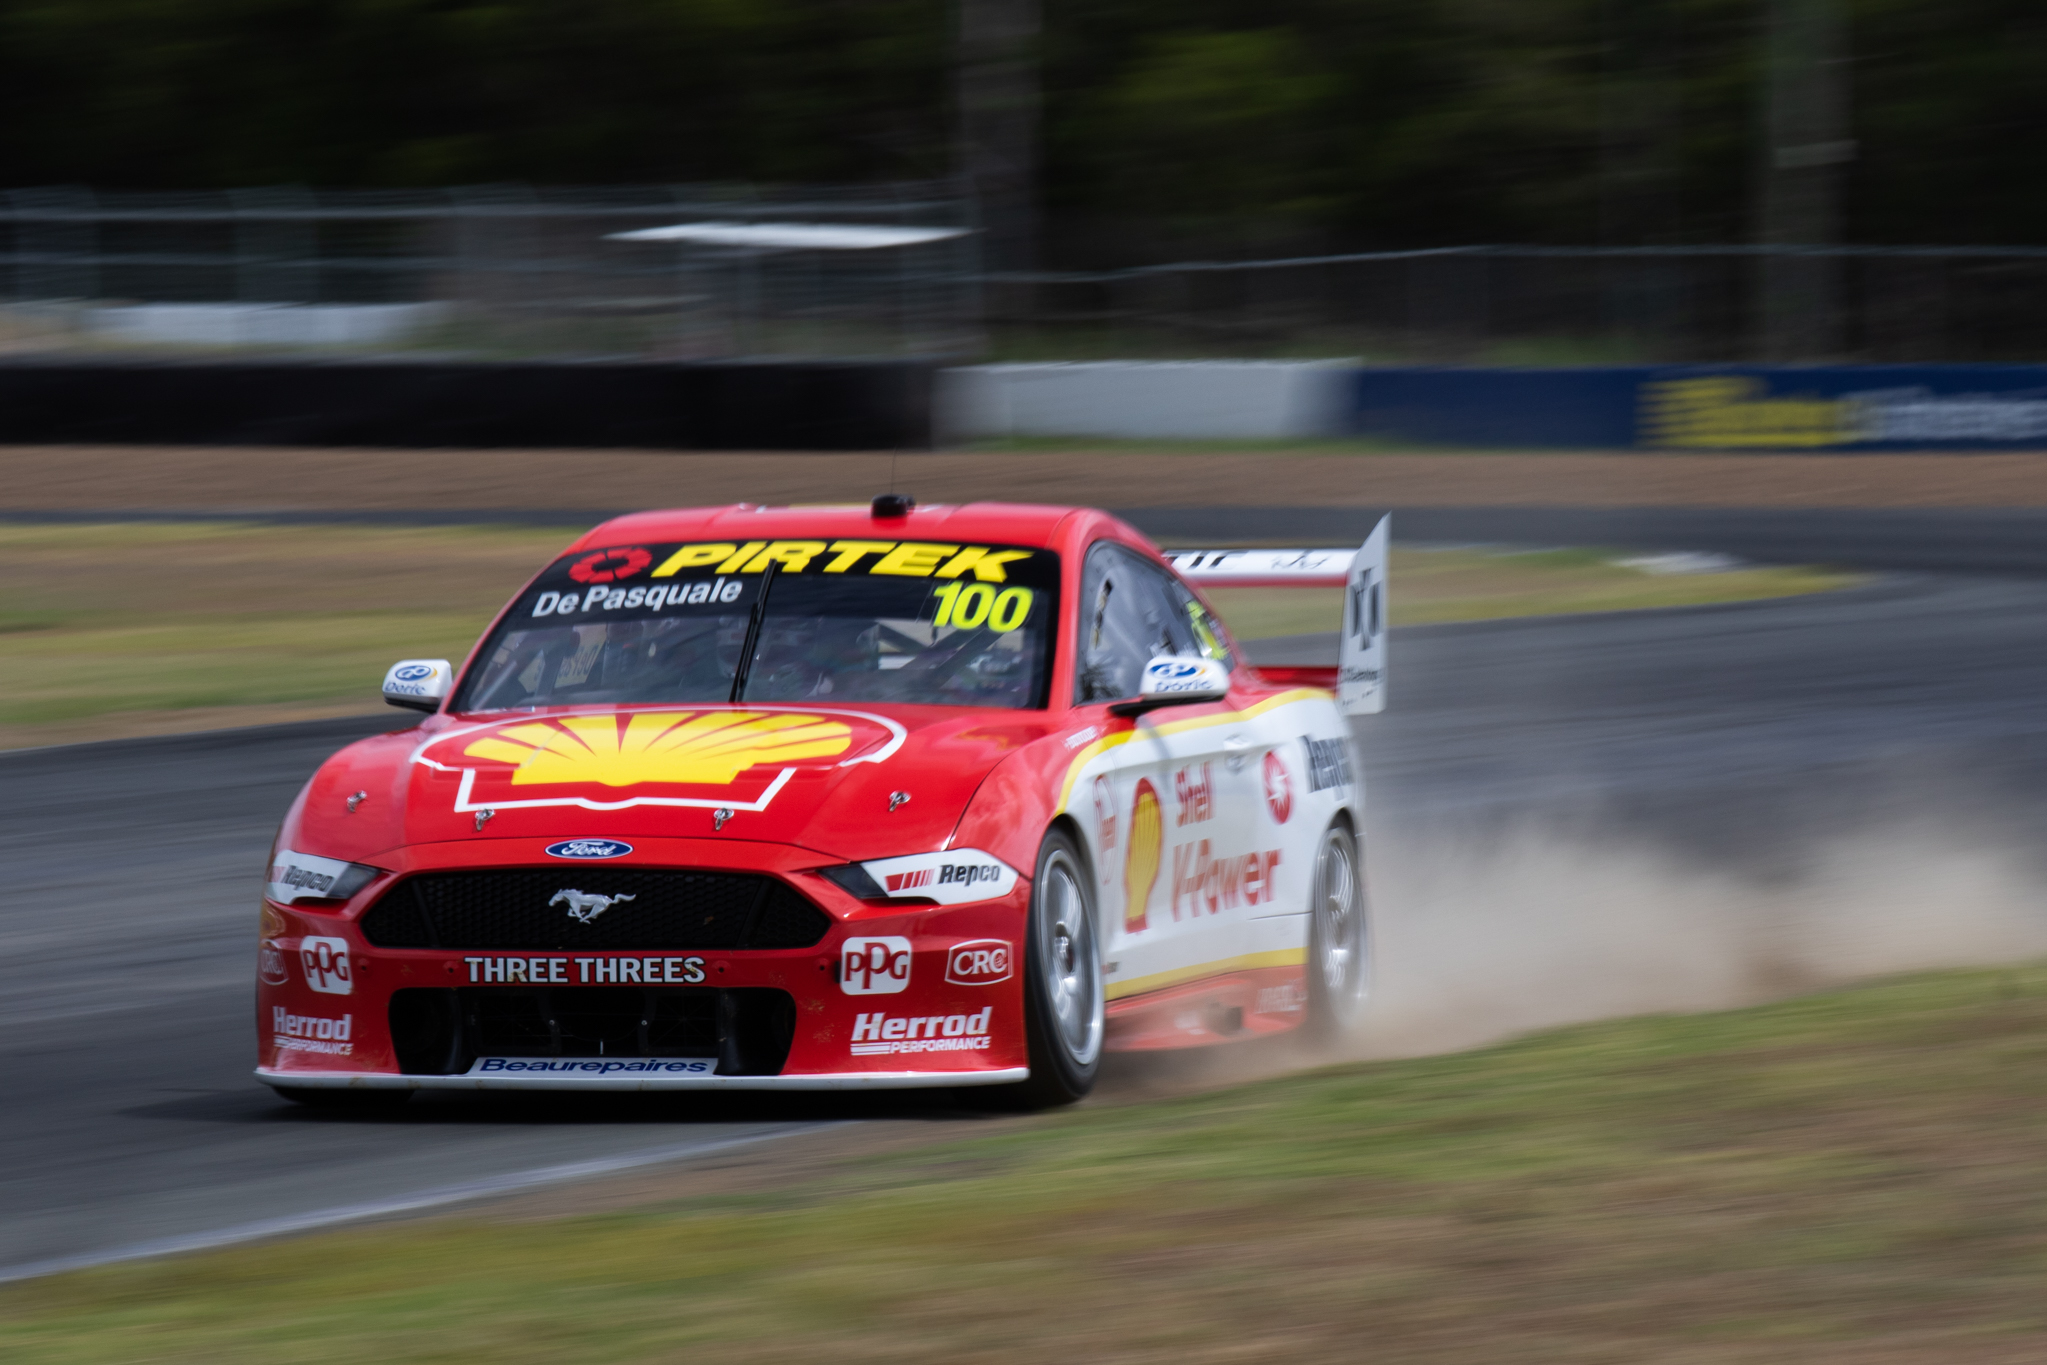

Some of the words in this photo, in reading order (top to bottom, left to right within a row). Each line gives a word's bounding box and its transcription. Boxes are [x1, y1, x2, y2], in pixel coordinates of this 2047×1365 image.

[651, 540, 1035, 582] PIRTEK
[531, 591, 577, 617] De
[581, 577, 743, 612] Pasquale
[933, 581, 1034, 632] 100
[385, 682, 426, 695] Doric
[561, 841, 617, 856] Ford
[281, 865, 335, 893] Repco
[937, 864, 1000, 887] Repco
[301, 942, 350, 988] PPG
[464, 956, 569, 984] THREE
[574, 956, 706, 984] THREES
[844, 943, 909, 990] PPG
[953, 948, 1008, 976] CRC
[272, 1006, 352, 1041] Herrod
[850, 1006, 993, 1041] Herrod
[889, 1036, 991, 1055] PERFORMANCE
[480, 1058, 708, 1076] Beaurepaires
